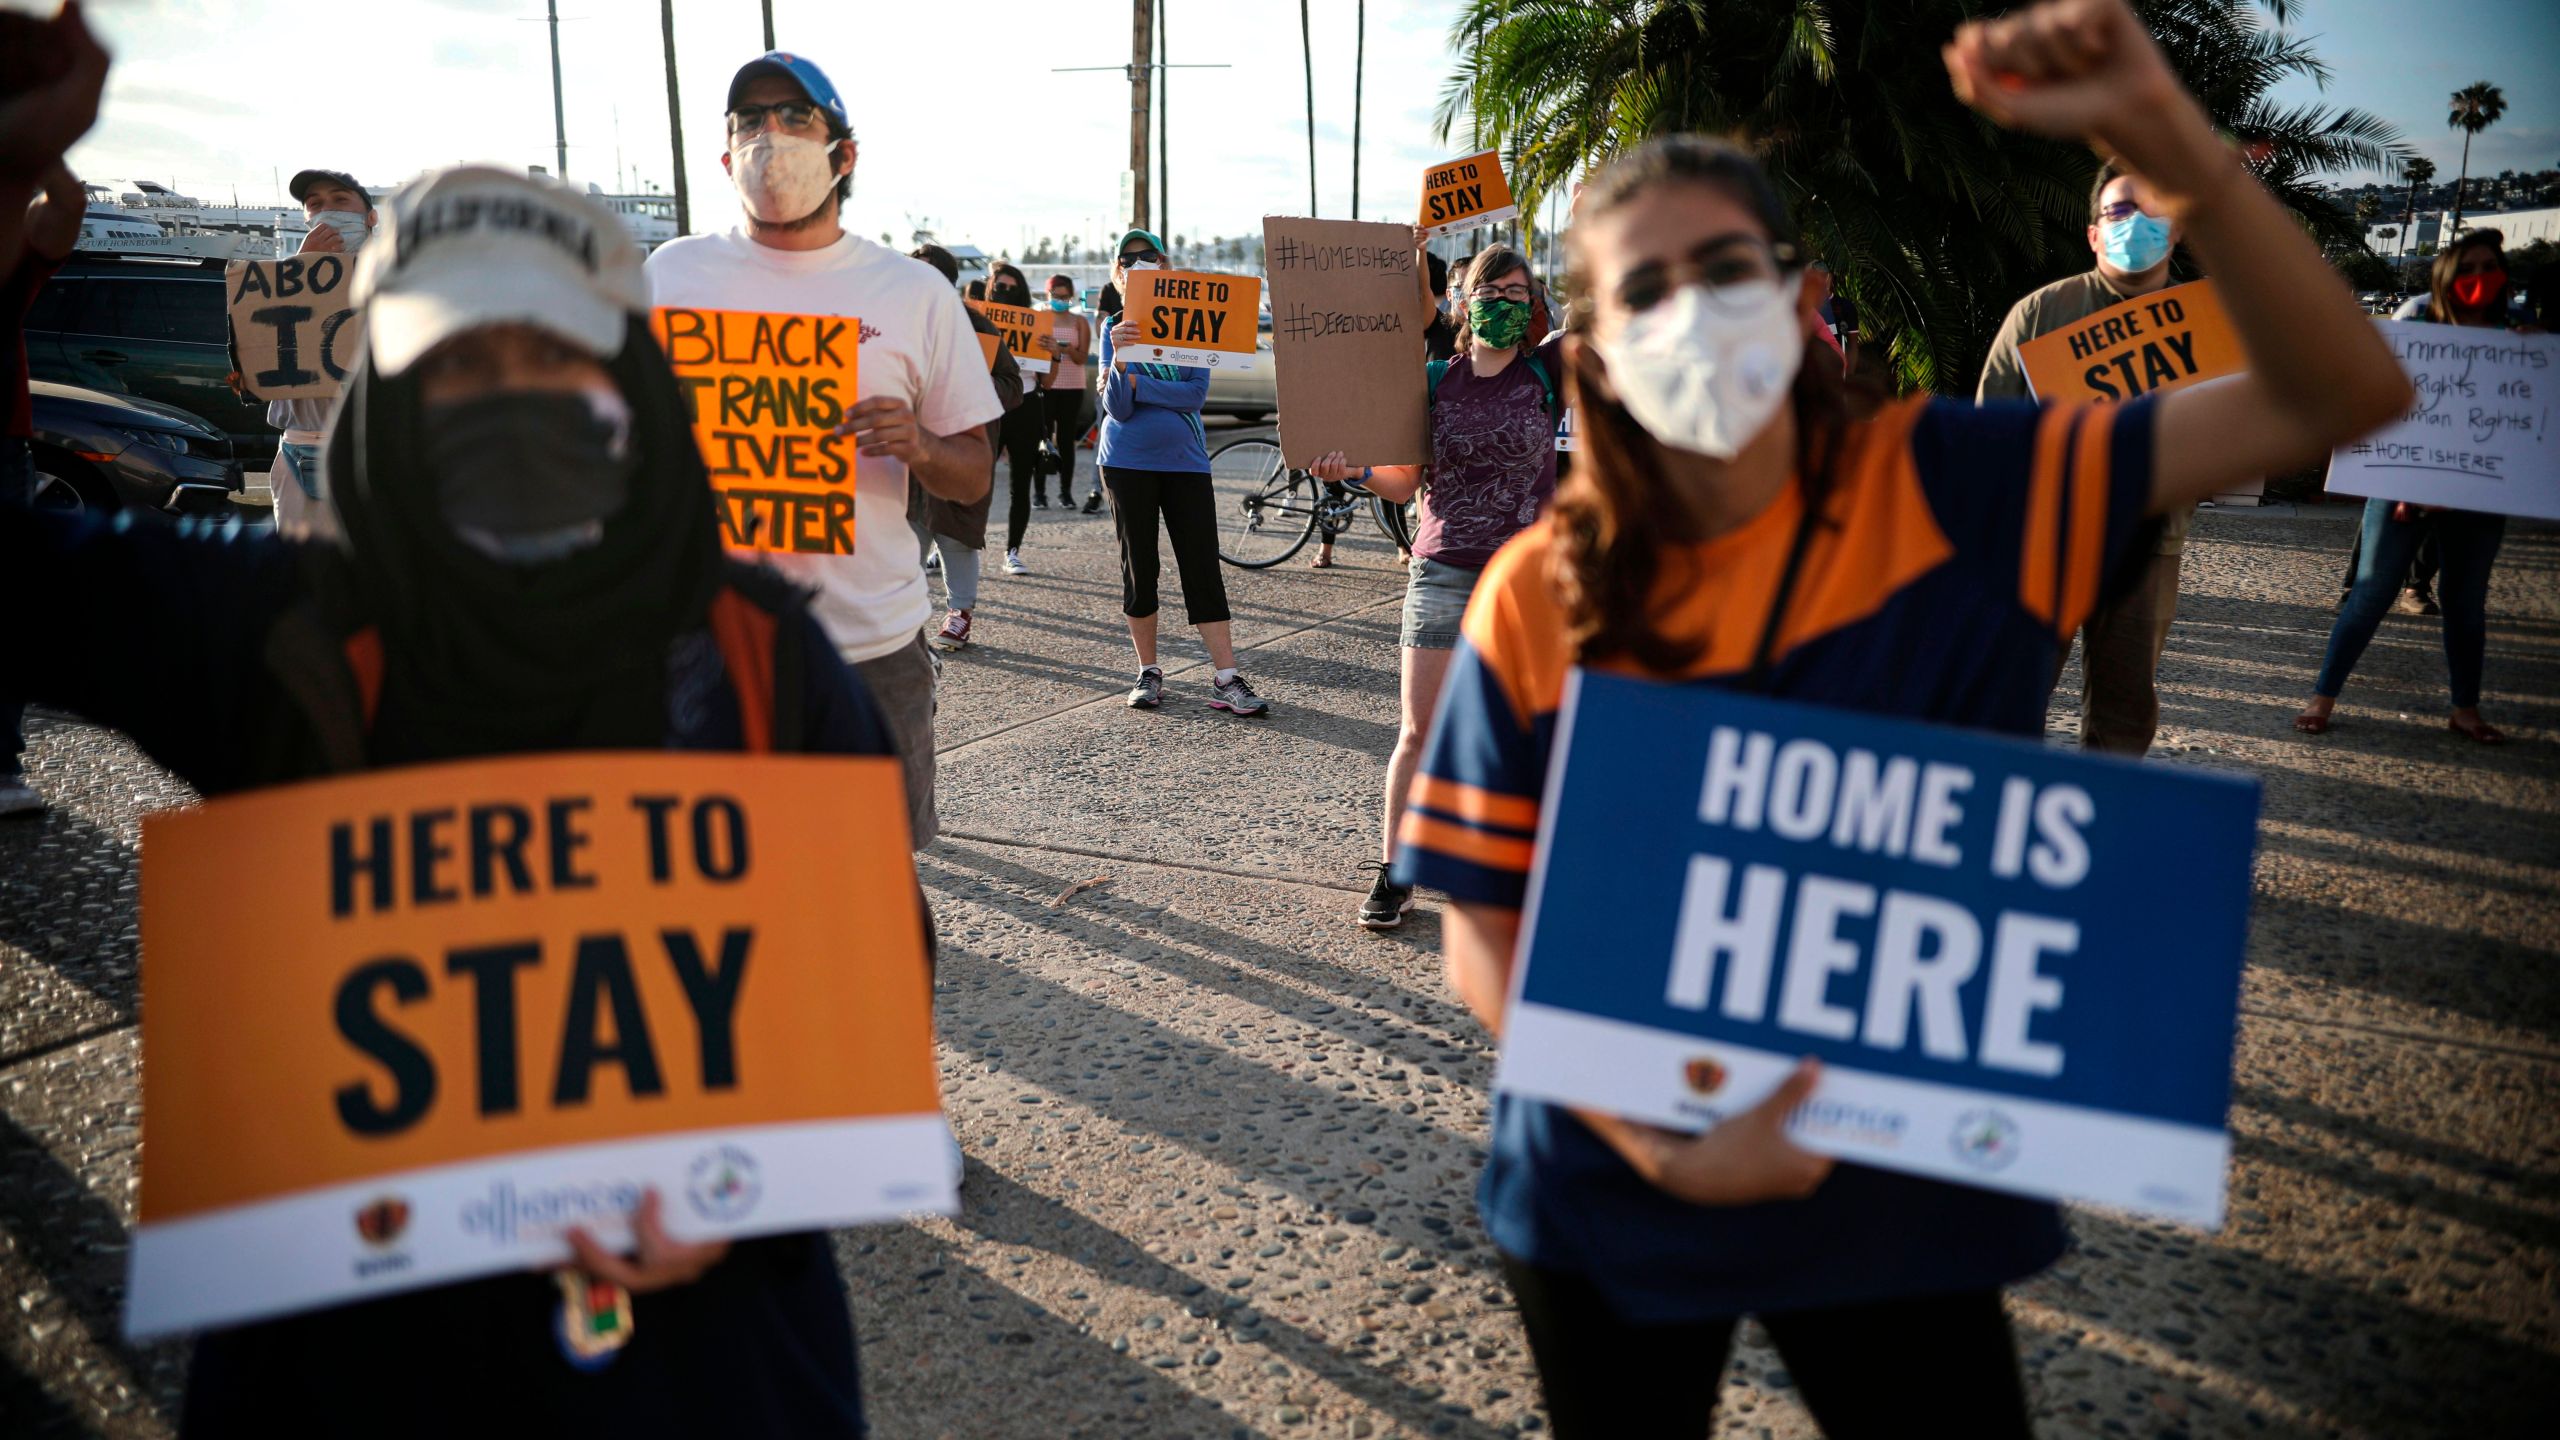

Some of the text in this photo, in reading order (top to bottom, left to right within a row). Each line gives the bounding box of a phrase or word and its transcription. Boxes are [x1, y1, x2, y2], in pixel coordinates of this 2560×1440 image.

[1426, 163, 1478, 190] HERE TO
[1428, 183, 1484, 221] STAY
[109, 238, 173, 249] HORNBLOWER
[1274, 235, 1411, 273] #HOMEISHERE
[233, 255, 358, 306] ABO
[1153, 277, 1229, 303] HERE TO
[665, 308, 846, 369] BLACK
[985, 307, 1035, 327] HERE TO
[997, 327, 1033, 353] TAY
[1150, 305, 1227, 344] STAY
[1283, 302, 1403, 343] #DEFENDDACA
[2068, 298, 2185, 361] HERE TO
[2083, 330, 2199, 402] STAY
[2497, 379, 2533, 399] are
[677, 373, 843, 430] TRANS
[2467, 406, 2549, 443] Rights!
[708, 430, 849, 485] IVES
[715, 488, 855, 556] ATTER
[1697, 724, 2097, 890] HOME IS
[330, 794, 752, 921] HERE TO
[1664, 851, 2082, 1079] HERE
[333, 925, 756, 1140] STAY
